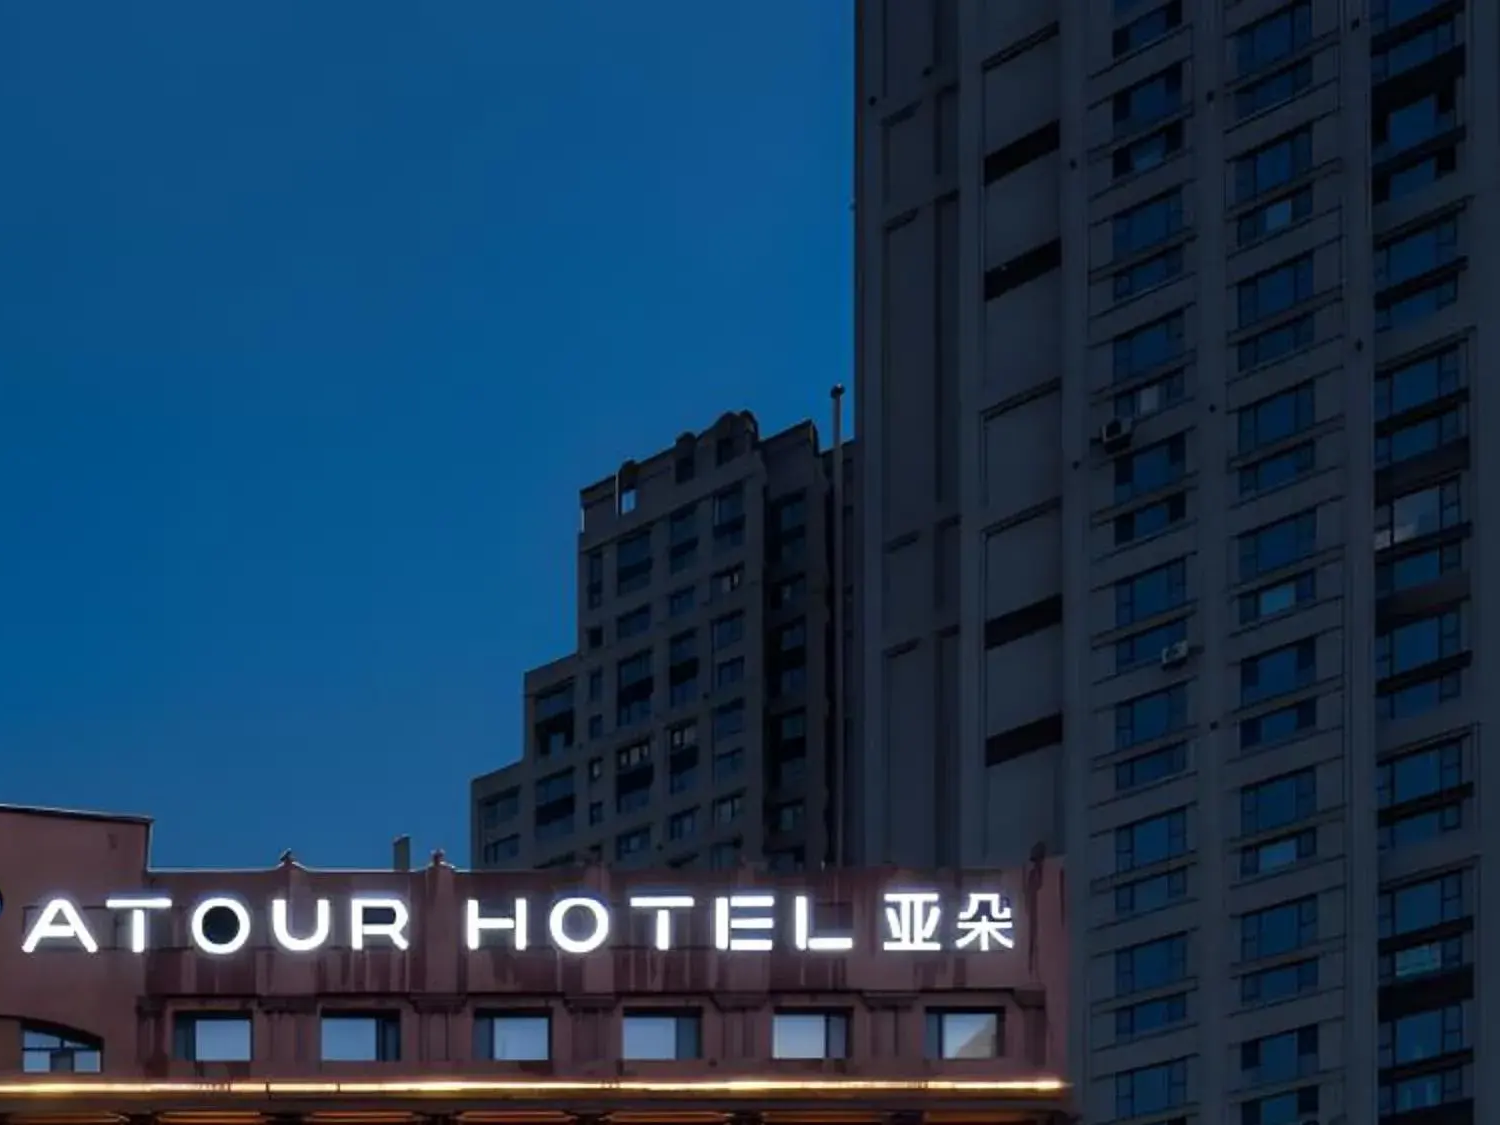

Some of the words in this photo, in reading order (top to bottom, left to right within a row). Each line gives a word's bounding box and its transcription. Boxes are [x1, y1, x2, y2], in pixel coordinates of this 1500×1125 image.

[21, 895, 410, 955] ATOUR
[465, 894, 854, 954] HOTEL
[882, 892, 1015, 952] 亚朵
